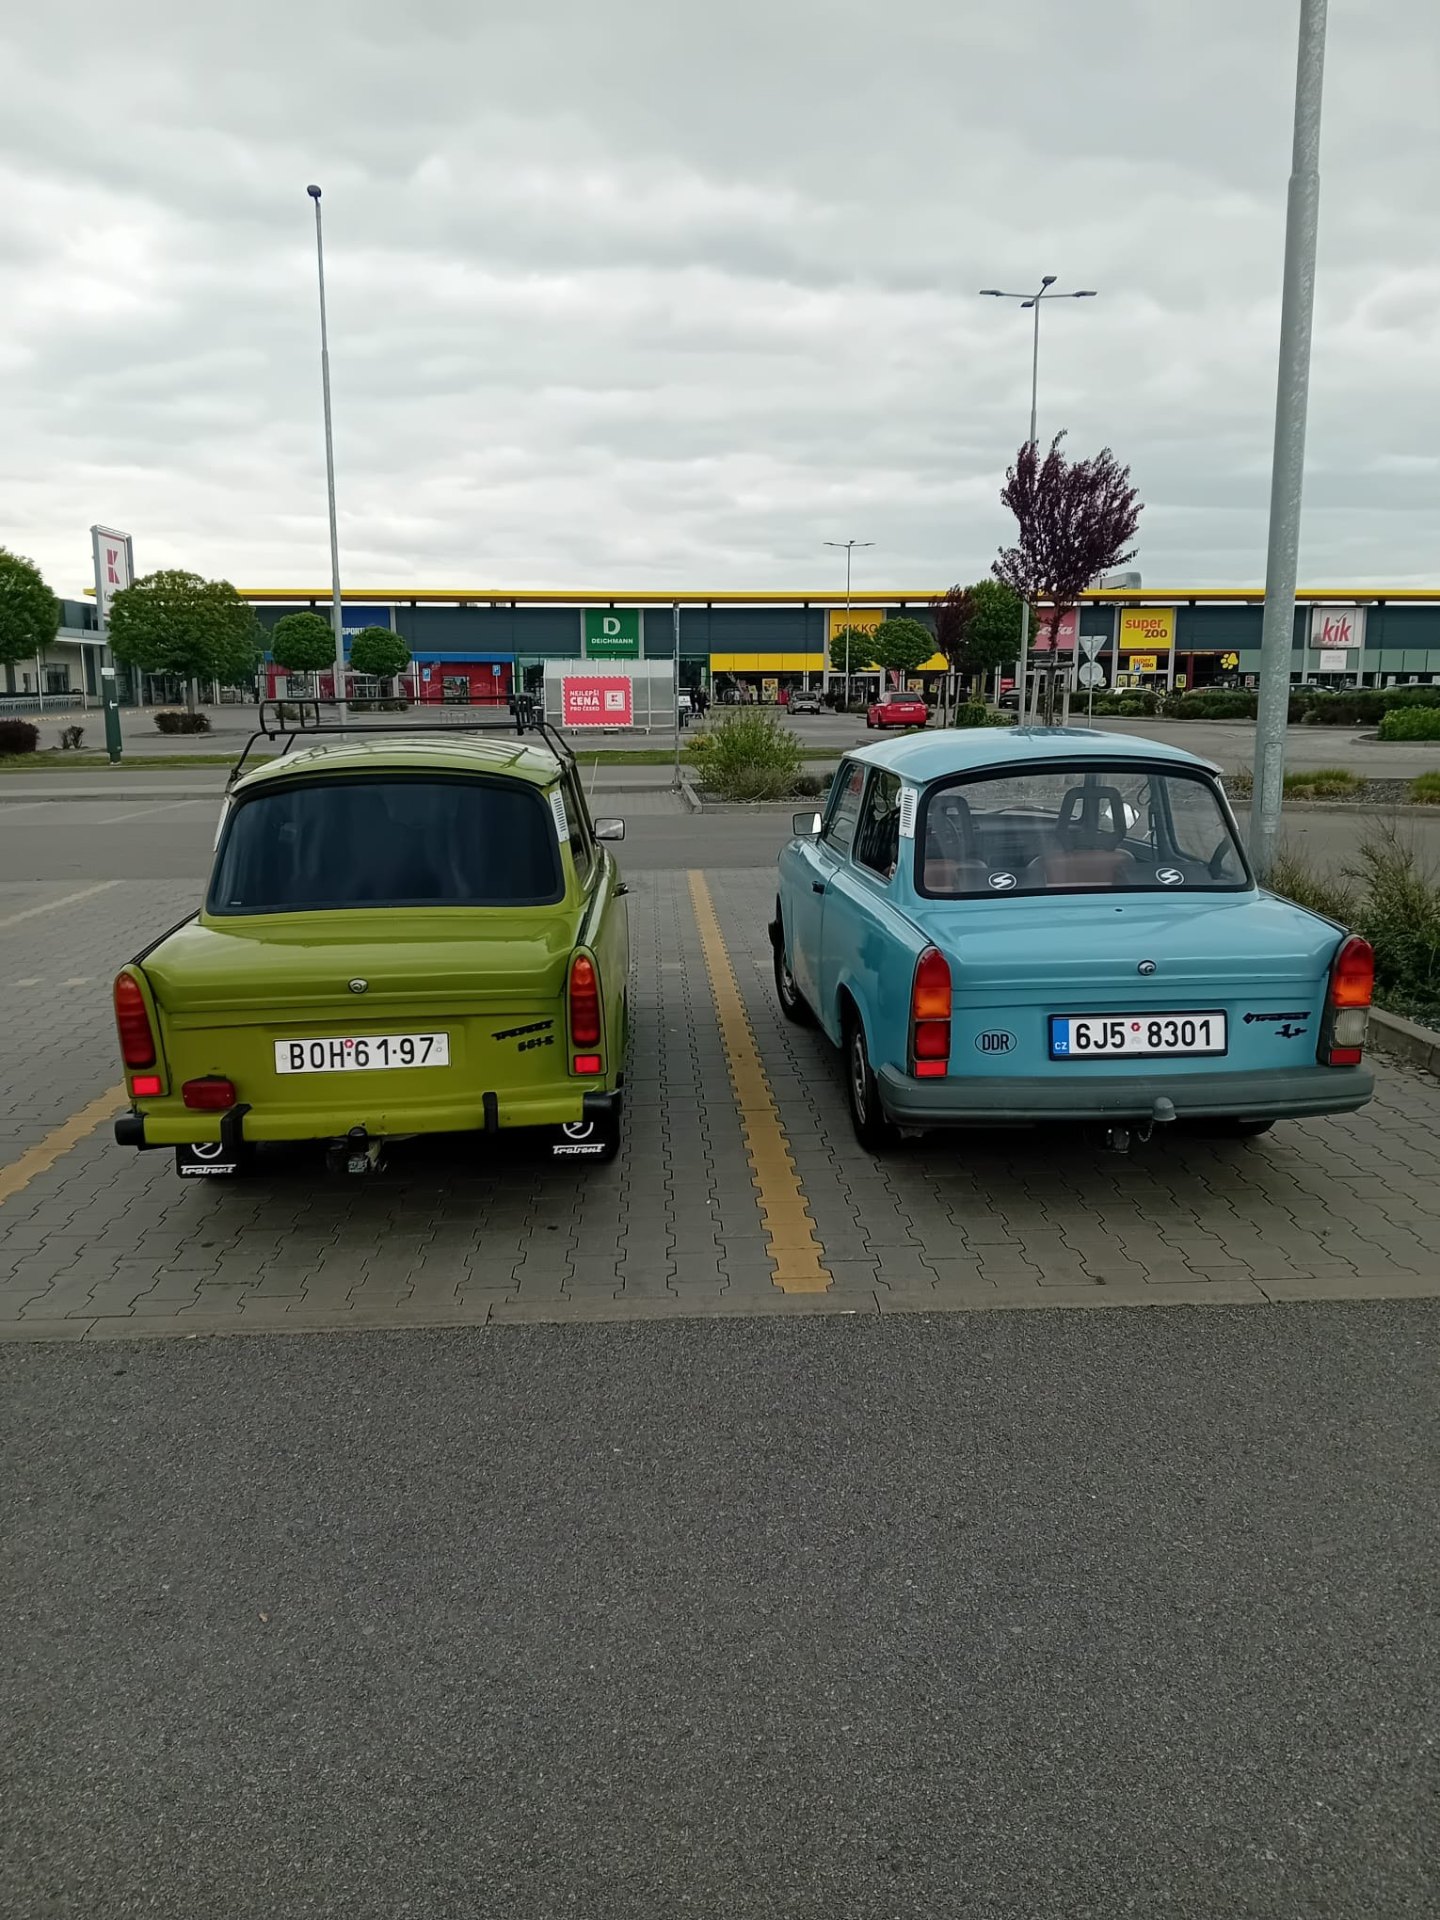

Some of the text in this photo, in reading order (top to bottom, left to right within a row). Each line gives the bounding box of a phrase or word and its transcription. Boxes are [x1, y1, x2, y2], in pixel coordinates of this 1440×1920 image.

[107, 549, 120, 584] K
[603, 617, 621, 635] D
[1125, 619, 1164, 631] super
[1144, 629, 1168, 638] zoo
[570, 697, 600, 705] CENA
[1076, 1020, 1211, 1050] 6J5 8301
[982, 1034, 1010, 1051] DDR
[1055, 1042, 1068, 1050] CZ
[553, 1143, 605, 1154] Trabant
[181, 1164, 237, 1175] Trabant
